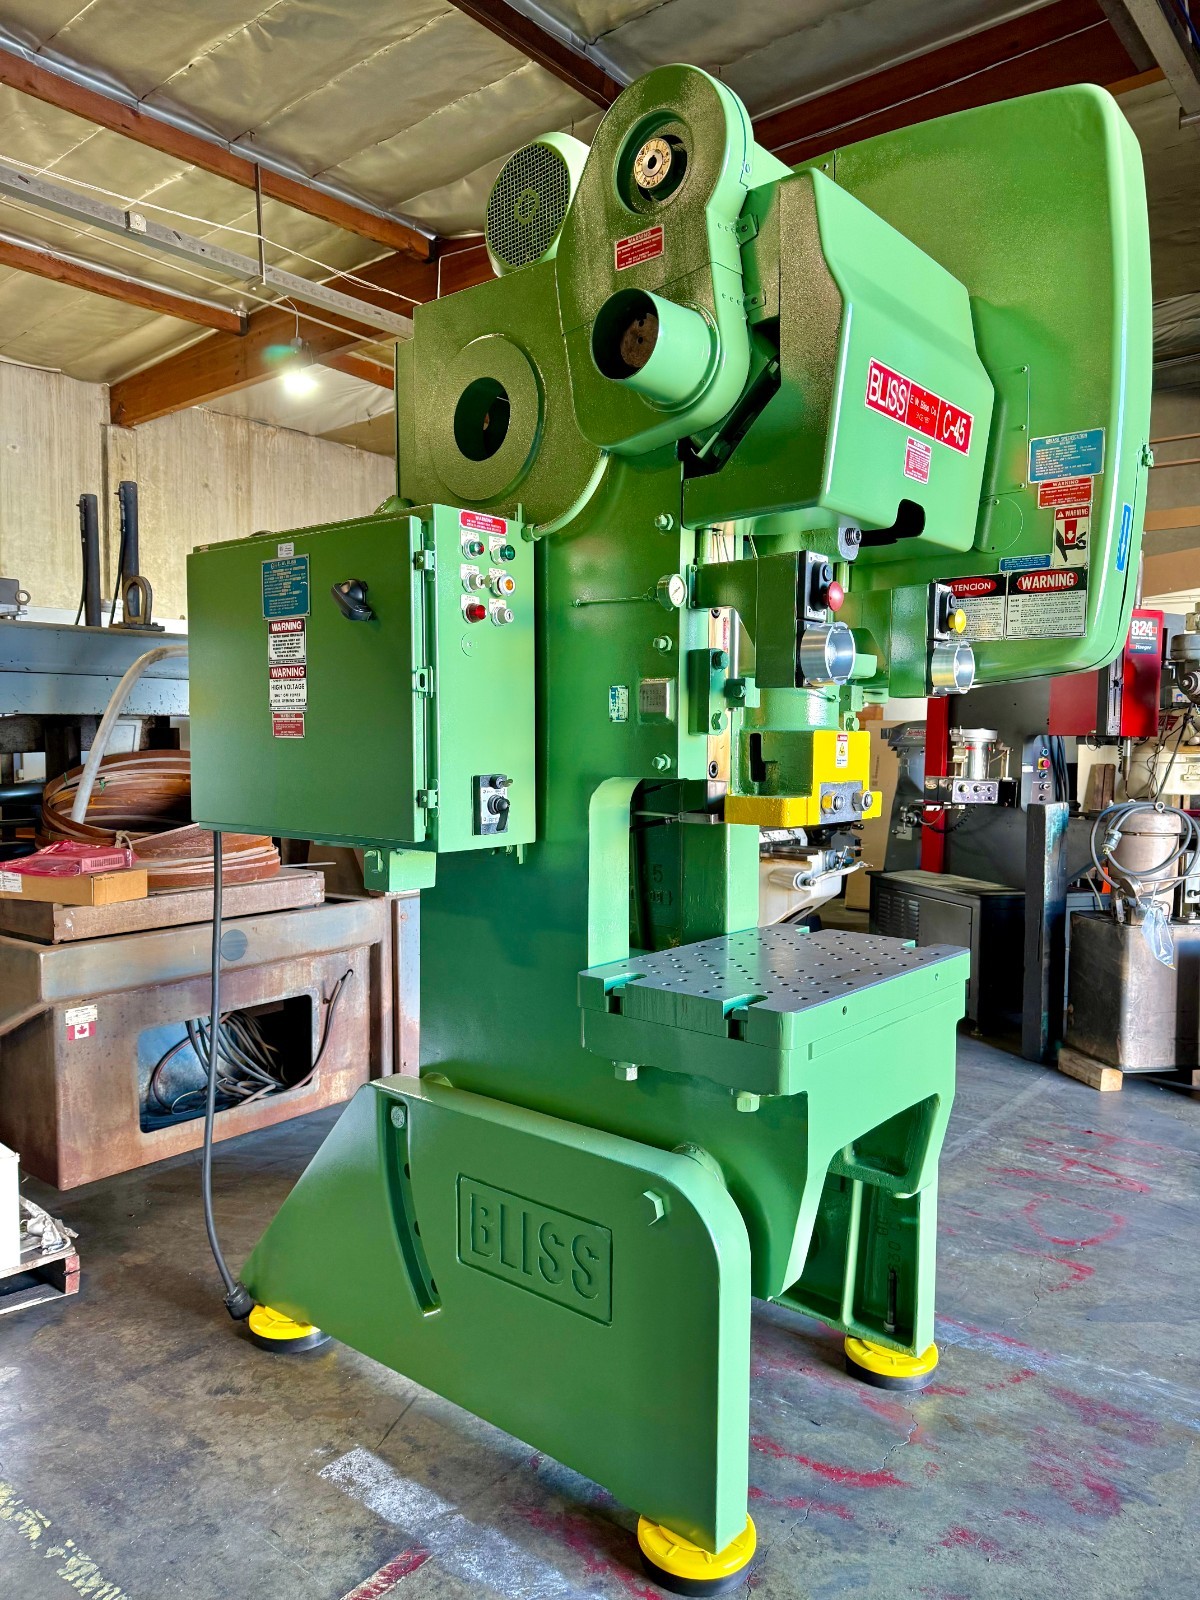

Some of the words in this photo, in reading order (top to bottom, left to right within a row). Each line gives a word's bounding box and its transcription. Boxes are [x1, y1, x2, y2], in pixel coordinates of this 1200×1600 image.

[868, 367, 907, 416] BLISS
[943, 410, 967, 446] C-45
[1065, 508, 1089, 518] WARNING
[1021, 572, 1075, 590] WARNING
[271, 621, 302, 631] WARNING
[1131, 620, 1152, 636] 824
[271, 667, 305, 678] WARNING
[470, 1192, 600, 1300] BLISS
